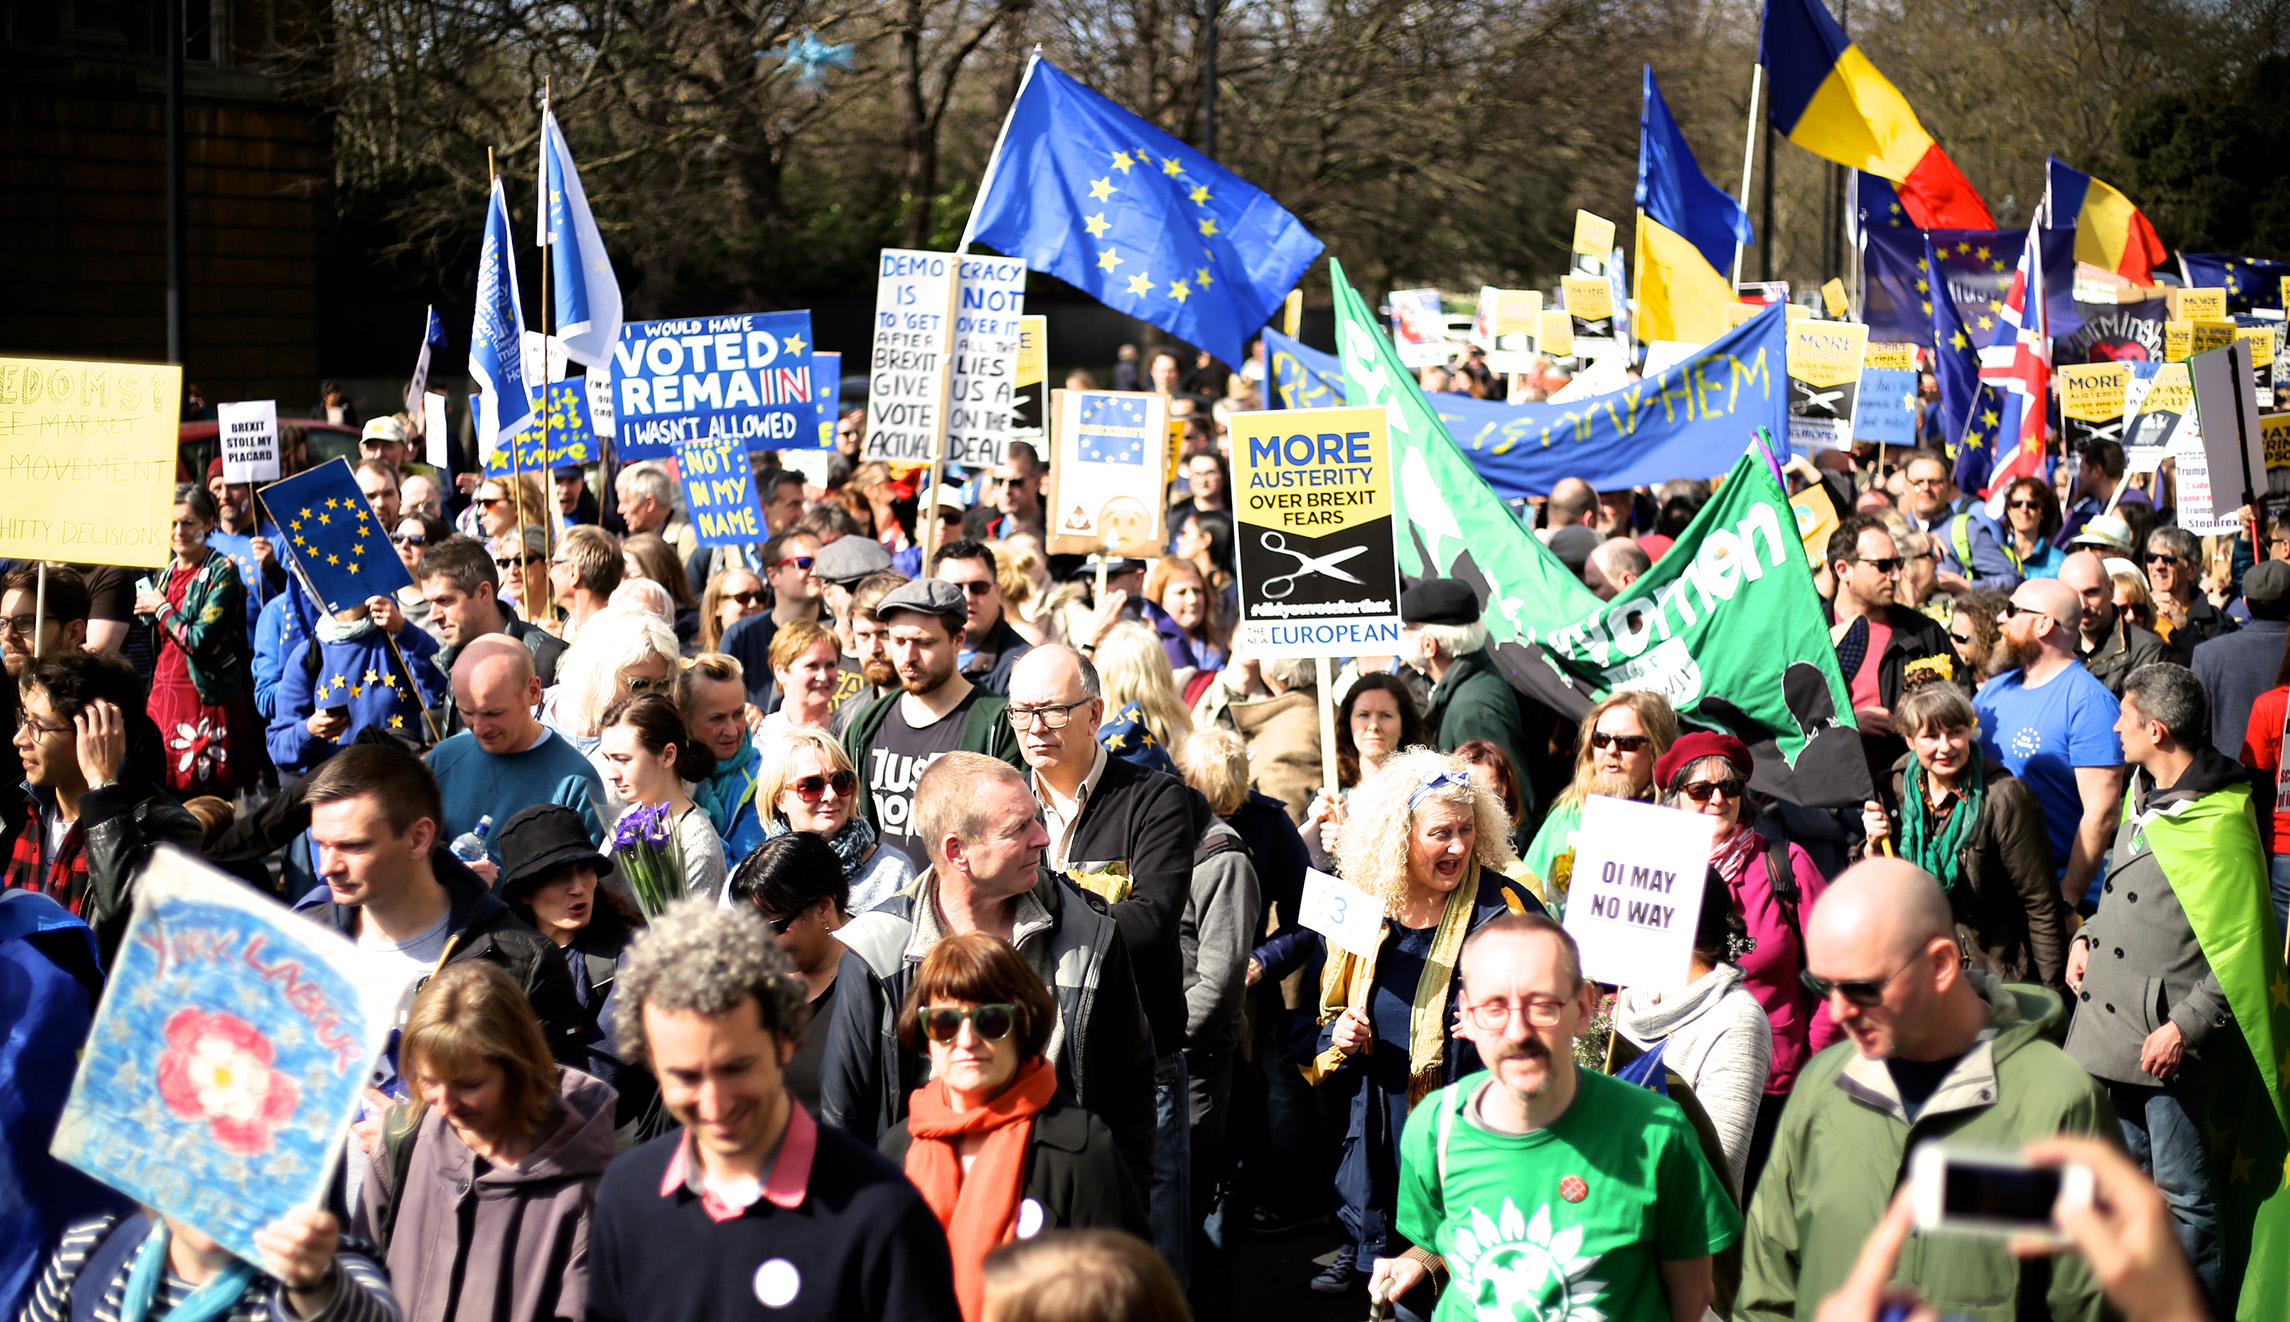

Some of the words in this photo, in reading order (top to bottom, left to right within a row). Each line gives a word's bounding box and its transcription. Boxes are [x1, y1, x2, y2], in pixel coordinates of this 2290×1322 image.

[881, 254, 945, 278] DEMO
[958, 261, 1023, 283] CRACY
[896, 285, 918, 305] IS
[962, 286, 1025, 312] NOT
[624, 325, 632, 339] I
[644, 320, 703, 338] WOULD
[708, 316, 753, 333] HAVE
[879, 311, 898, 328] TO
[956, 317, 999, 335] OVER
[1004, 320, 1019, 336] IT
[614, 330, 779, 377] VOTED
[877, 331, 934, 348] AFTER
[958, 338, 987, 352] ALL
[874, 347, 938, 372] BREXIT
[956, 355, 1006, 377] LIES
[620, 366, 813, 416] REMAIN
[873, 372, 930, 397] GIVE
[952, 379, 985, 402] US
[995, 381, 1011, 404] A
[2069, 374, 2124, 390] MORE
[40, 413, 139, 437] MARKET
[231, 421, 265, 433] BREXIT
[623, 422, 631, 447] I
[635, 416, 700, 446] WASN'T
[708, 411, 797, 440] ALLOWED
[873, 402, 933, 428] VOTE
[951, 407, 978, 429] ON
[984, 410, 1008, 432] THE
[226, 437, 255, 449] STOLE
[257, 435, 272, 447] MY
[867, 430, 932, 461] ACTUAL
[946, 434, 1006, 466] DEAL
[1249, 431, 1372, 468] MORE
[10, 454, 167, 484] MOVEMENT
[228, 450, 273, 464] PLACARD
[685, 446, 732, 476] NOT
[688, 480, 711, 508] IN
[711, 476, 747, 505] MY
[1250, 467, 1373, 489] AUSTERITY
[1250, 493, 1302, 510] OVER
[1307, 490, 1376, 507] BREXIT
[698, 506, 759, 539] NAME
[1283, 510, 1344, 526] FEARS
[62, 520, 162, 547] DECISIONS
[1271, 622, 1399, 645] EUROPEAN
[1601, 861, 1625, 886] OI
[1629, 866, 1678, 894] MAY
[1330, 896, 1348, 925] 3
[1590, 893, 1621, 919] NO
[1627, 900, 1676, 929] WAY
